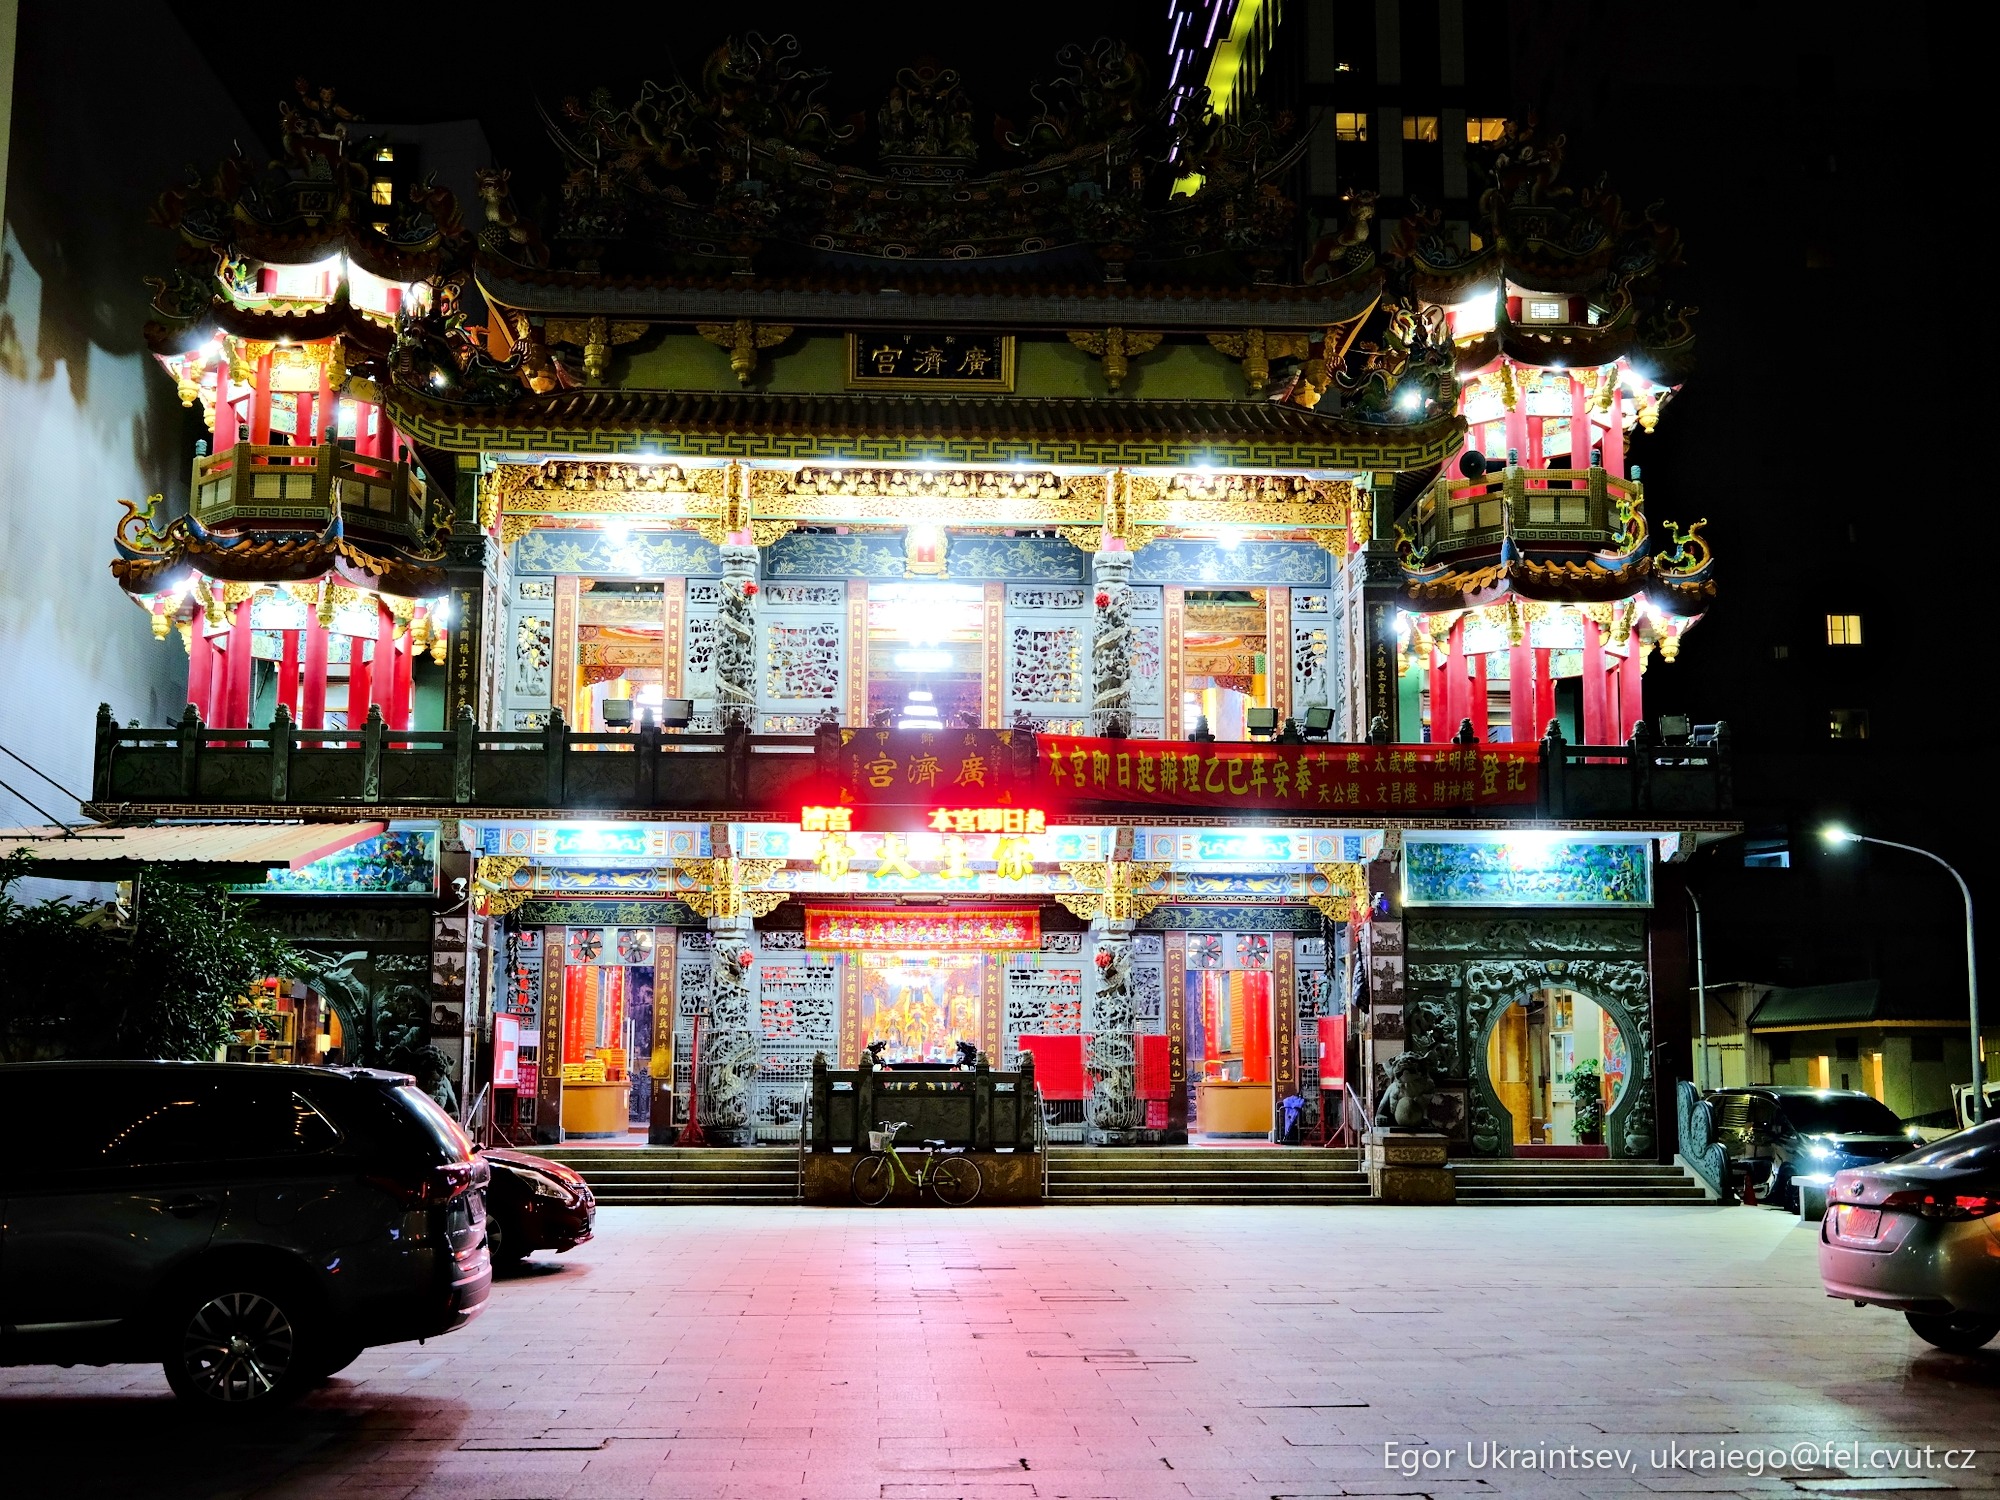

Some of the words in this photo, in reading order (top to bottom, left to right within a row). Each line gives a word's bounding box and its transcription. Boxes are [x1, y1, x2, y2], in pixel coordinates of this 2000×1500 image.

[871, 344, 992, 376] 廣濟宮
[863, 750, 989, 788] 廣濟宮
[1048, 742, 1313, 798] 本宮即日起辦理乙巳年安奉
[1480, 752, 1527, 796] 登記
